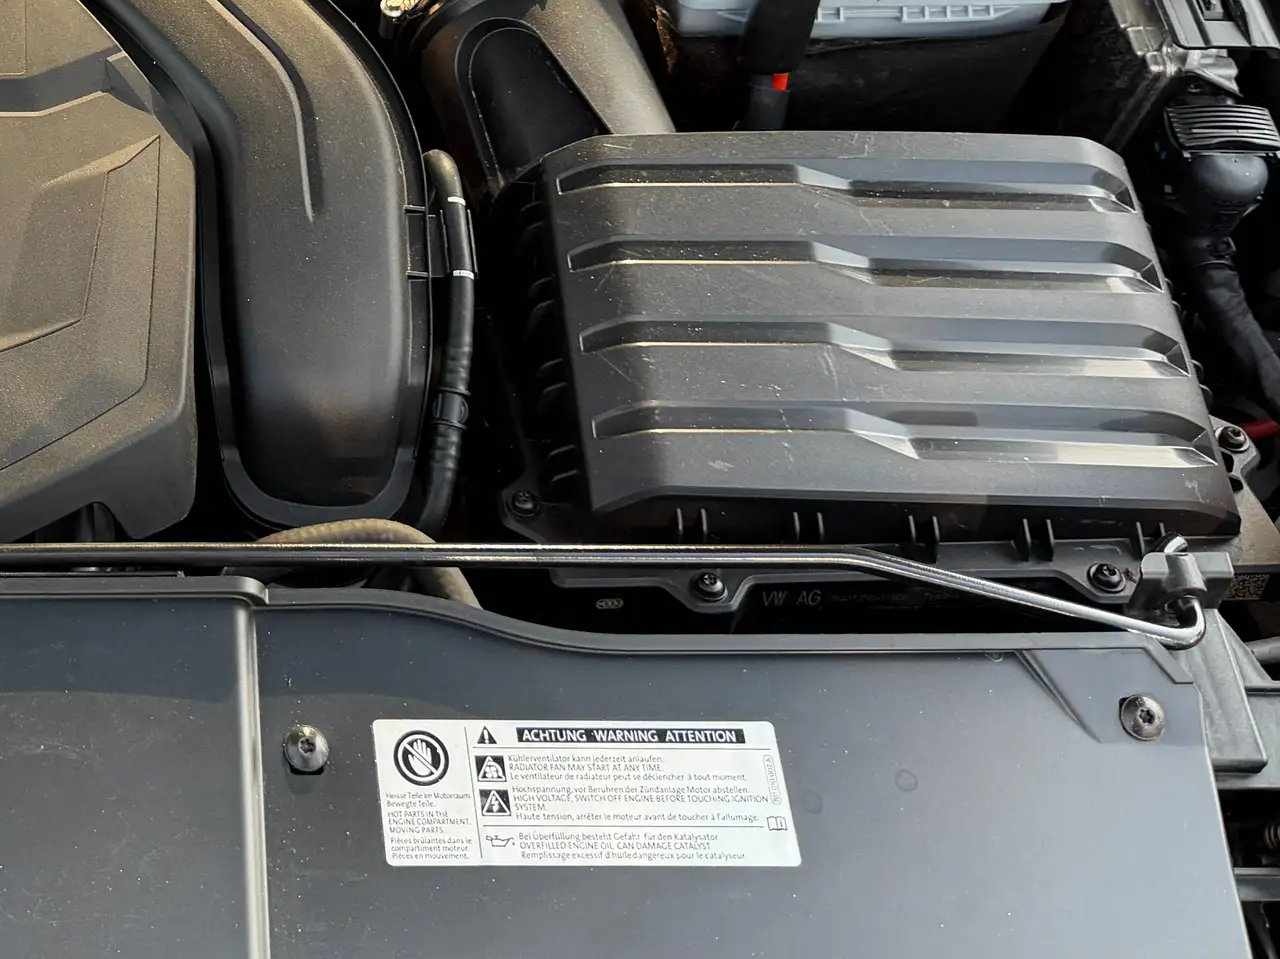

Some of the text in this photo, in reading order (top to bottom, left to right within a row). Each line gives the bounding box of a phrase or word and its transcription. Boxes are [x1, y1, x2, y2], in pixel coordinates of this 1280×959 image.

[762, 591, 787, 606] VW
[796, 590, 821, 606] AG
[523, 729, 737, 742] ACHTUNG WARNING ATTENTION
[508, 754, 570, 763] Kühlerventilator
[572, 754, 591, 763] kann
[592, 755, 626, 764] jederzeit
[614, 774, 631, 782] peut
[574, 786, 586, 794] vor
[625, 786, 637, 794] der
[640, 786, 684, 795] Zündanlage
[687, 786, 710, 794] Motor
[387, 800, 416, 808] Bewegte
[543, 814, 574, 822] tension,
[519, 832, 531, 840] Bei
[534, 832, 580, 842] Überfüllung
[582, 832, 612, 840] besteht
[614, 832, 640, 840] Gefahr
[644, 832, 656, 840] für
[658, 832, 672, 840] den
[520, 842, 566, 850] OVERFILLED
[568, 842, 599, 850] ENGINE
[616, 842, 634, 850] CAN
[636, 842, 672, 850] DAMAGE
[415, 852, 424, 860] en
[522, 852, 570, 860] Remplissage
[572, 852, 602, 860] excessif
[676, 852, 694, 860] pour
[696, 852, 704, 860] le
